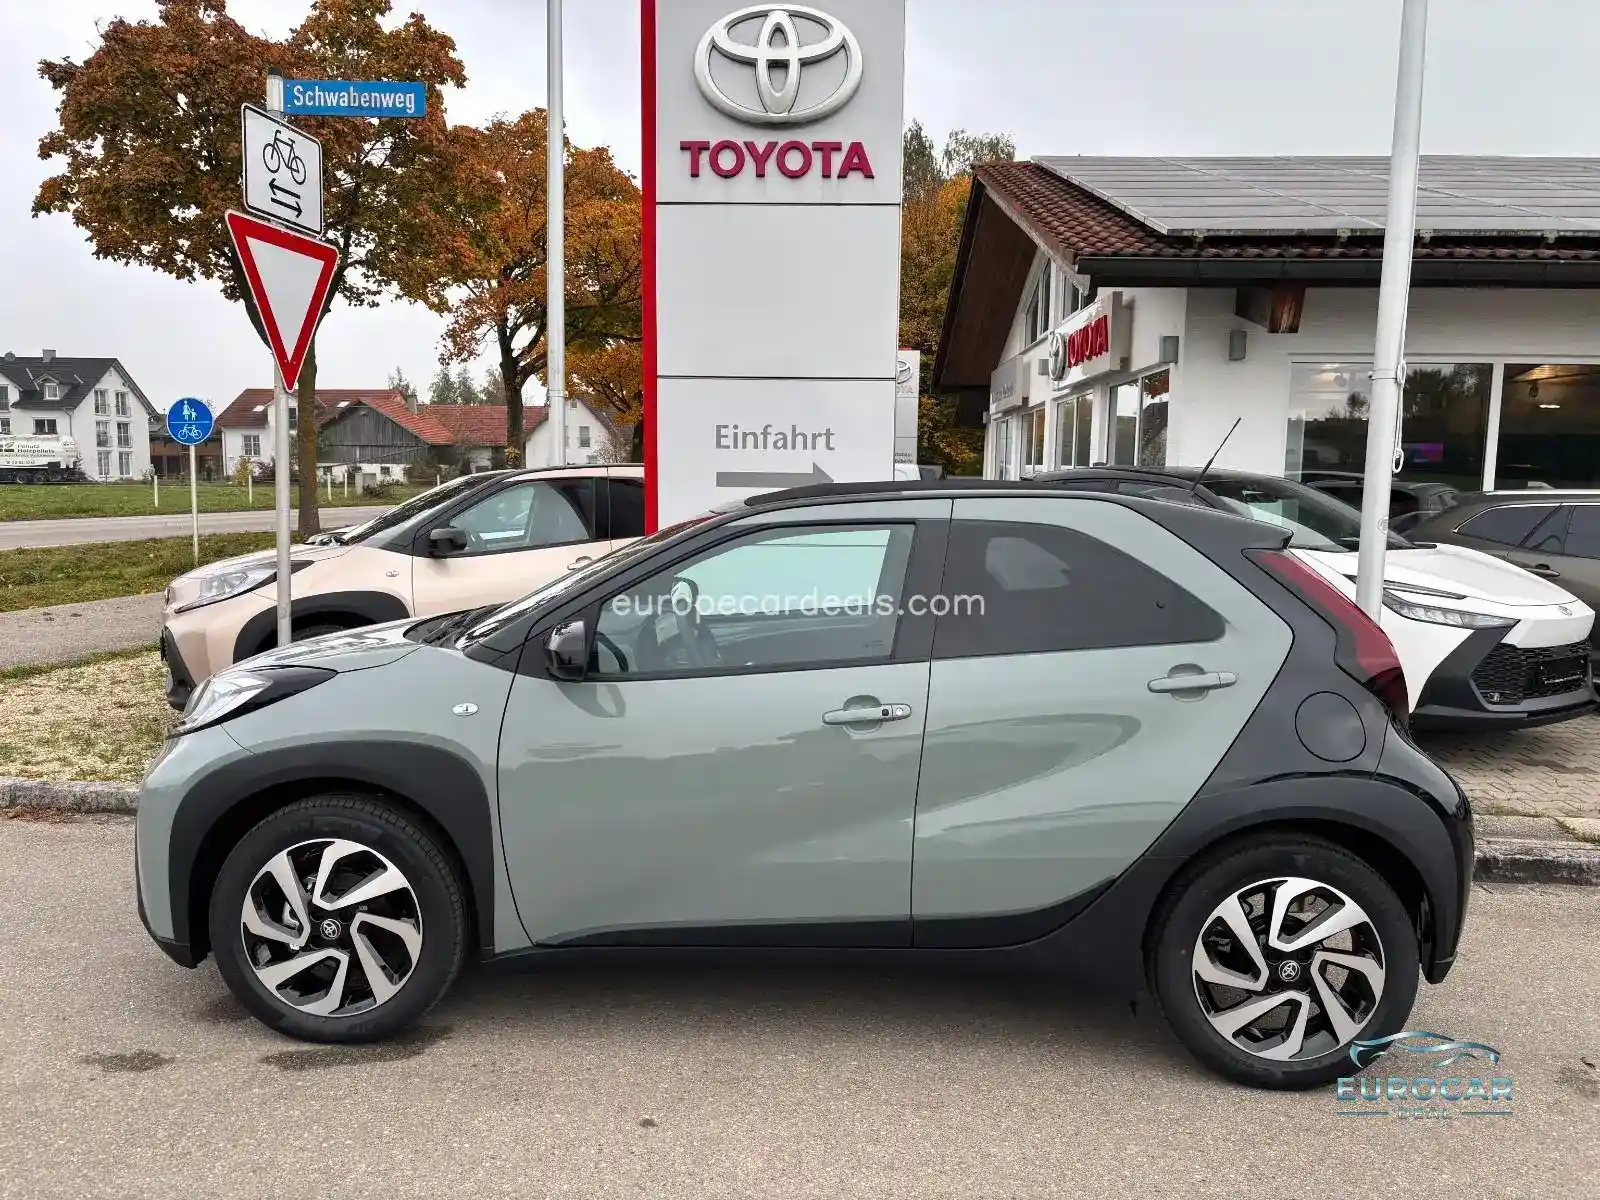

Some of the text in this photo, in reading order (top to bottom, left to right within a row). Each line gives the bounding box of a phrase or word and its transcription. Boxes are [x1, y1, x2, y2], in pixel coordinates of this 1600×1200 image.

[293, 85, 415, 114] Schwabenweg
[680, 140, 874, 179] TOYOTA
[1067, 314, 1109, 369] TOYOTA
[715, 423, 836, 451] Einfahrt
